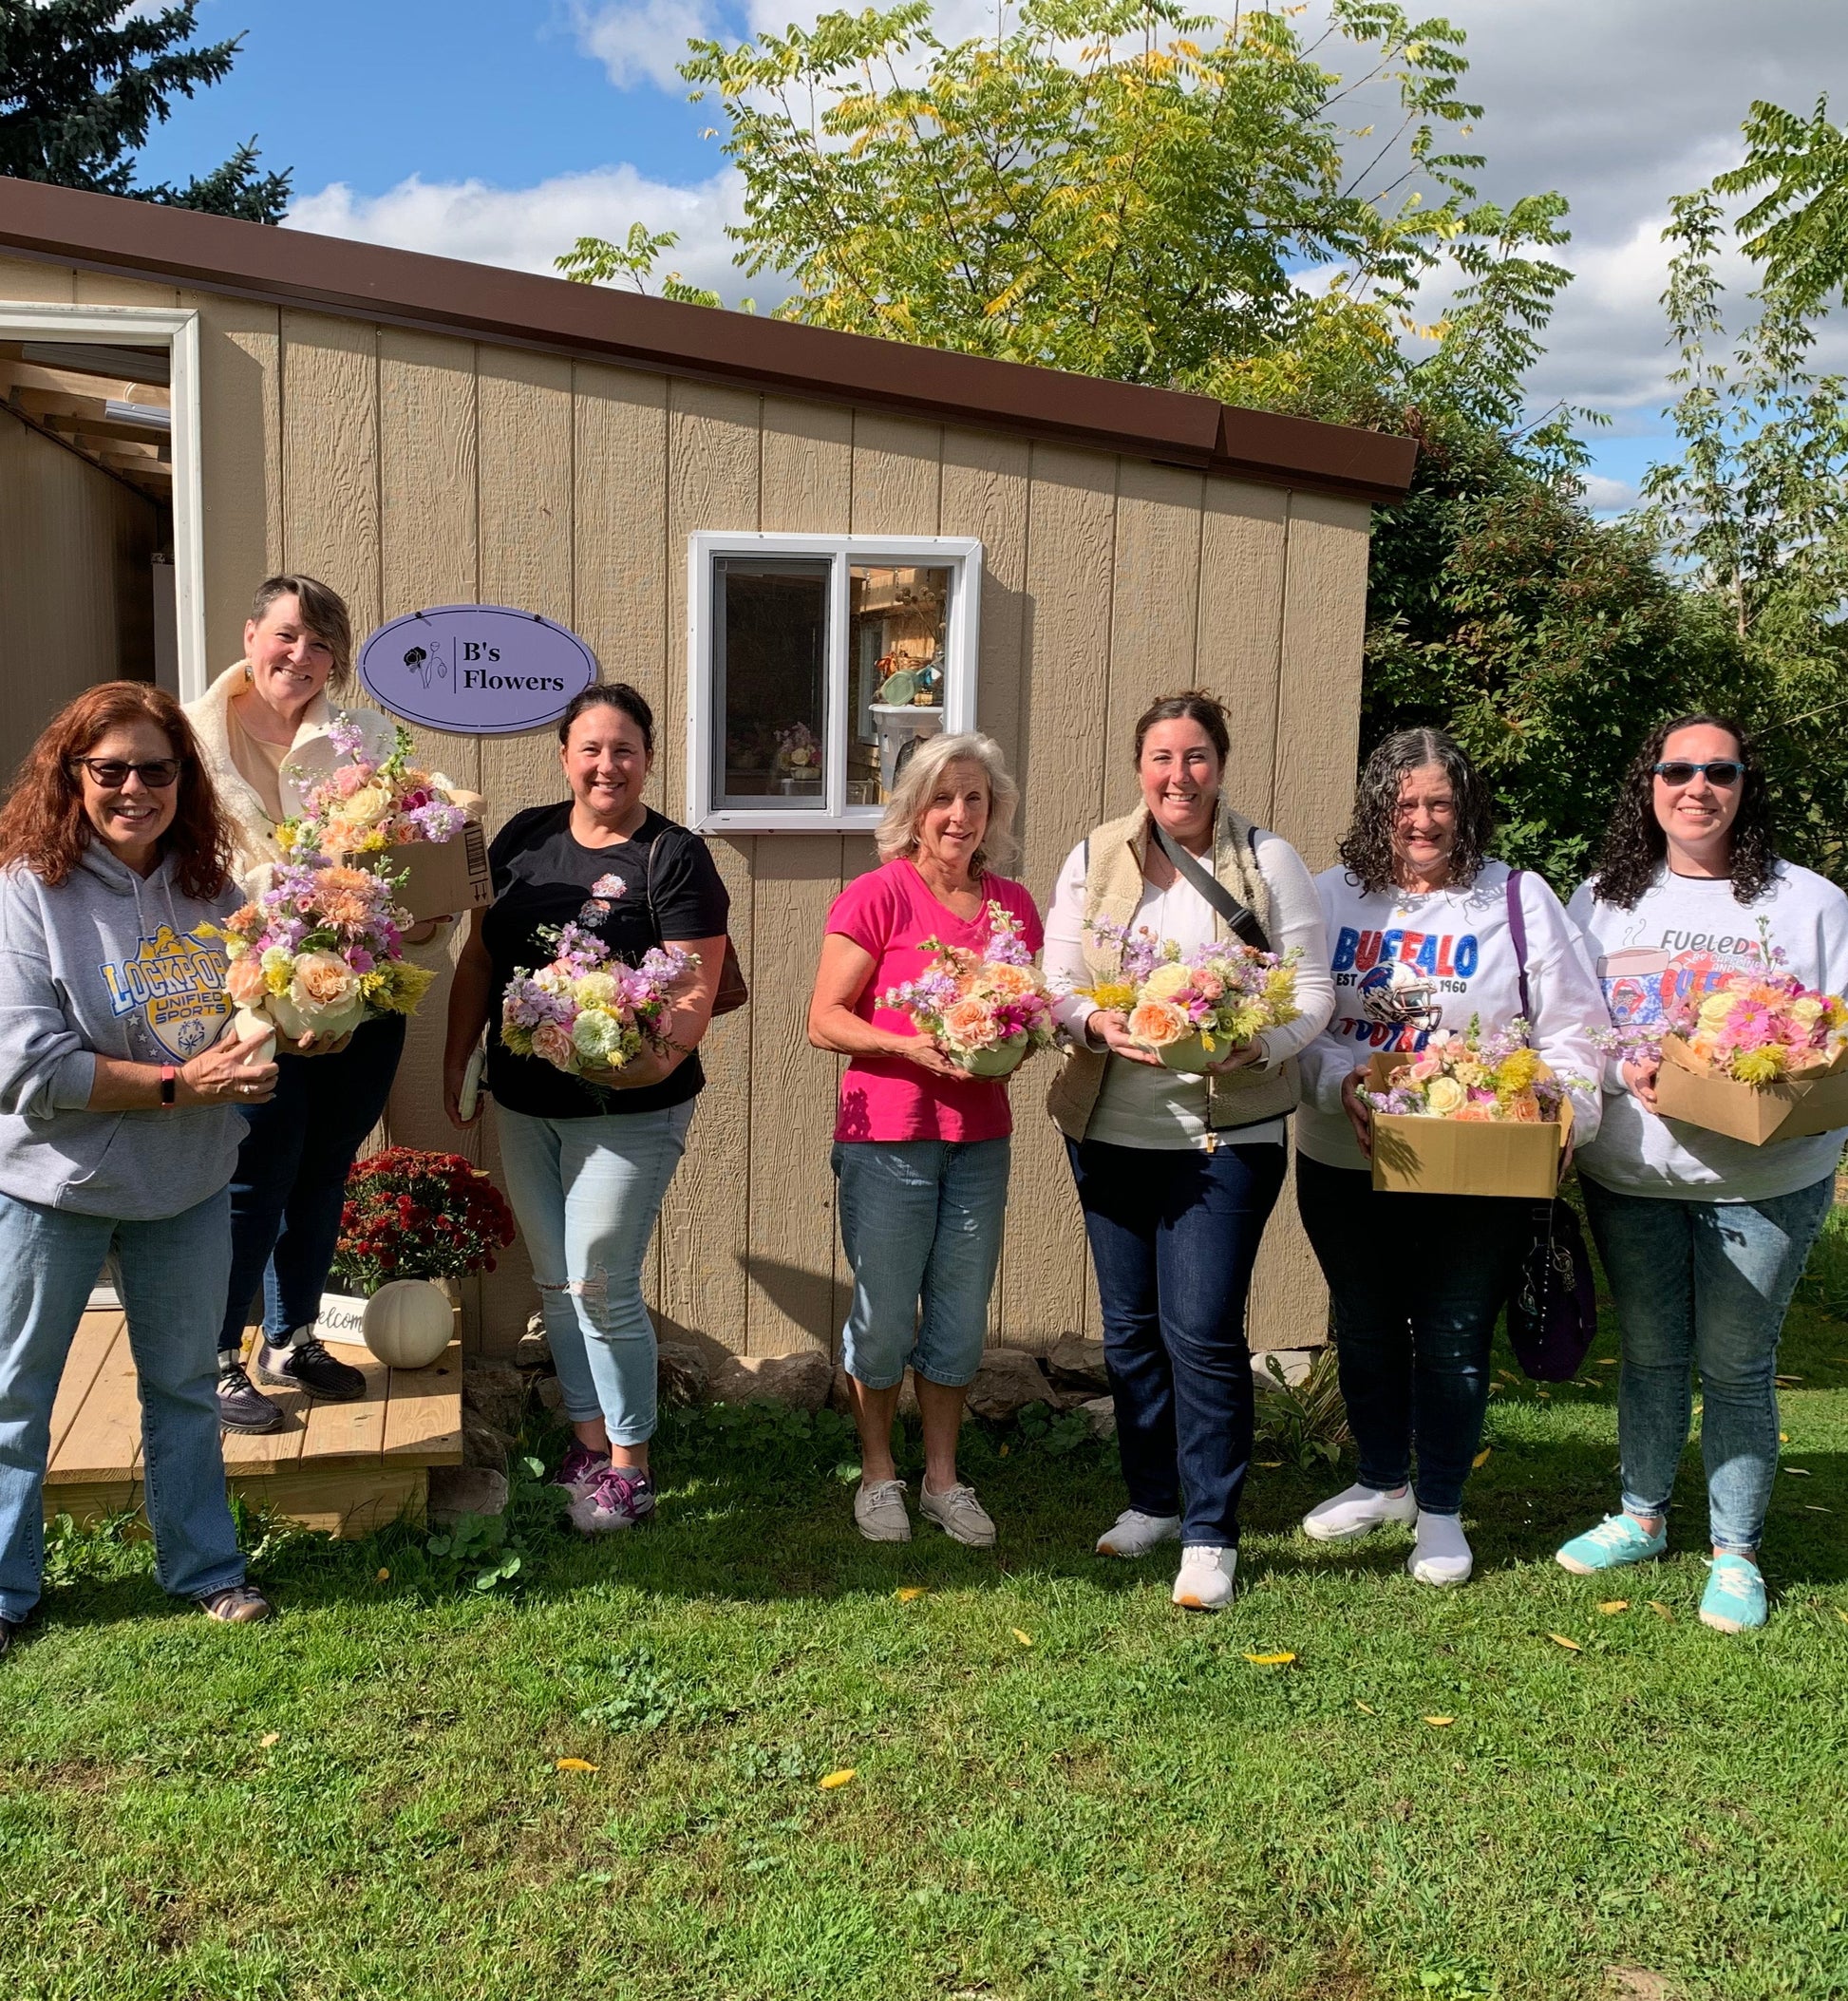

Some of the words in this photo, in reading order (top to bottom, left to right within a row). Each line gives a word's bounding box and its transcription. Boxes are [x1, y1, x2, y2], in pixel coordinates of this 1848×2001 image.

[463, 642, 500, 662] B's
[463, 669, 564, 691] Flowers
[1331, 926, 1479, 978] BUFFALO
[1711, 963, 1734, 973] AND
[98, 948, 229, 1017] LOCKPOR
[1336, 973, 1358, 987] EST
[1440, 980, 1467, 993] 1960
[156, 991, 223, 1011] UNIFIED
[156, 1003, 227, 1025] SPORTS
[318, 1307, 363, 1333] elcom
